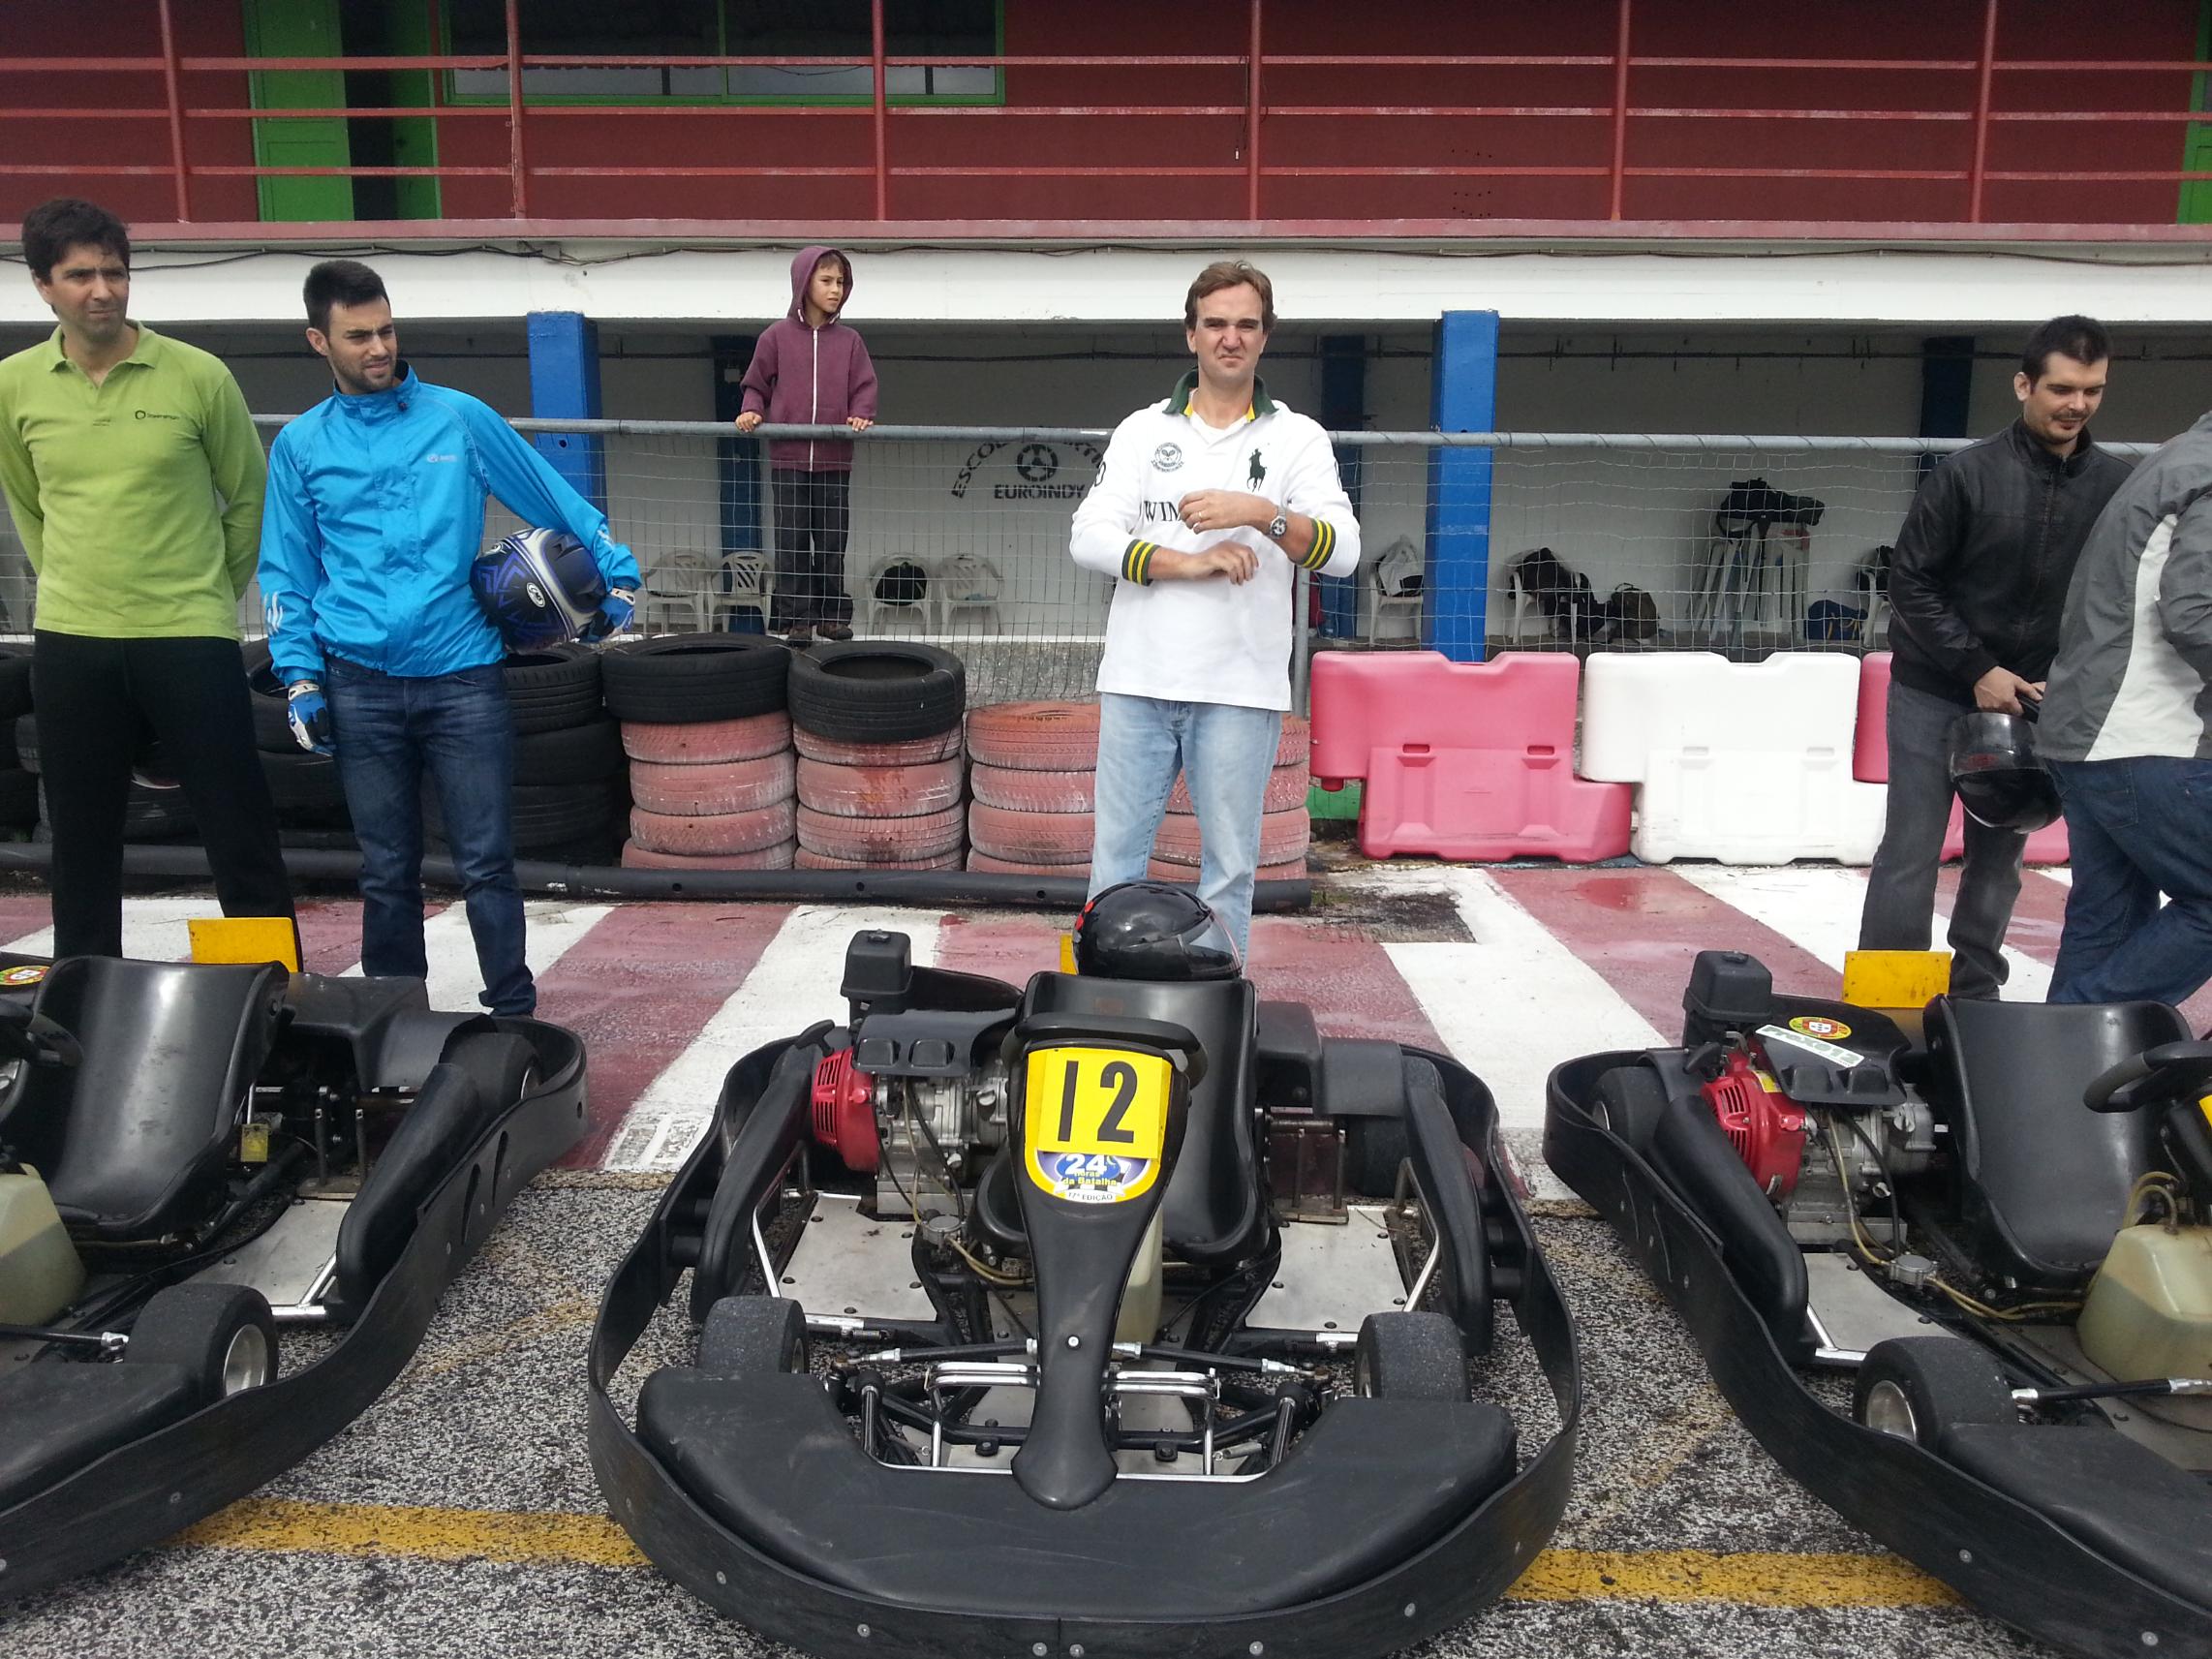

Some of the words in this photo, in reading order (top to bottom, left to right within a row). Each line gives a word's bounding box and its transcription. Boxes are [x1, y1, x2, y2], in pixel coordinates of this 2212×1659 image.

[994, 484, 1086, 500] EUROINDY
[1058, 1060, 1137, 1144] 12
[1064, 1152, 1107, 1175] 24
